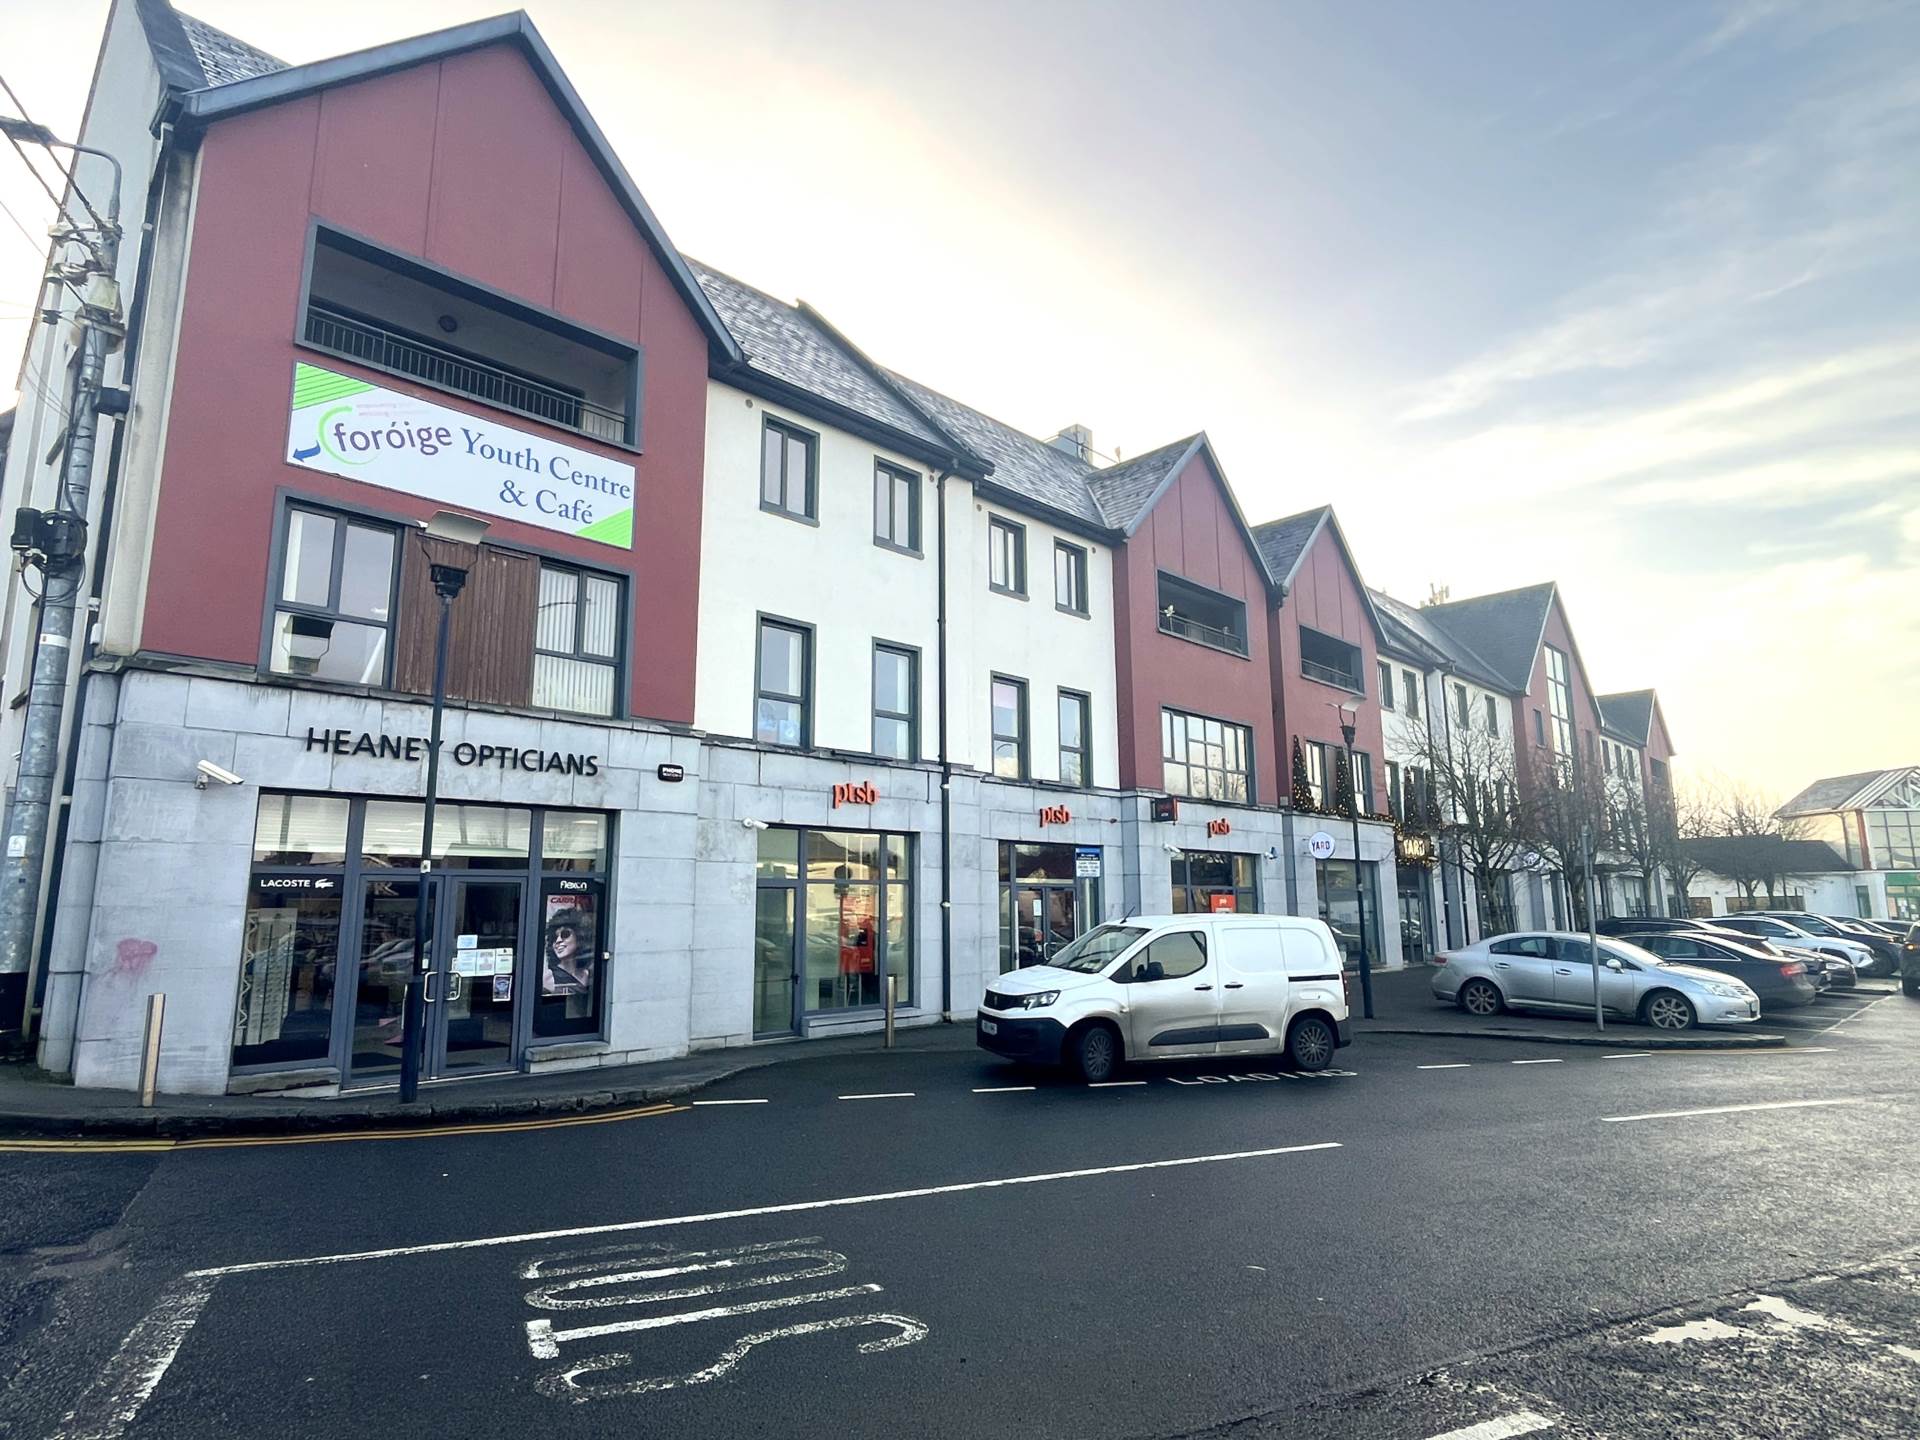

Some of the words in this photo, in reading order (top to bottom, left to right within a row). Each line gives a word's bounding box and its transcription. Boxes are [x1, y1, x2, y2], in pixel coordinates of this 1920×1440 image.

[333, 421, 453, 456] foróige
[459, 428, 541, 474] Youth
[549, 455, 632, 500] Centre
[499, 479, 529, 507] &
[535, 487, 595, 525] Café
[306, 726, 444, 763] HEANEY
[453, 742, 599, 777] OPTICIANS
[832, 780, 880, 809] ptsb
[1039, 804, 1072, 828] ptsb
[1311, 840, 1331, 852] YARD
[1403, 839, 1426, 857] YARD
[260, 879, 311, 888] LACOSTE
[1166, 1068, 1358, 1085] LOADING
